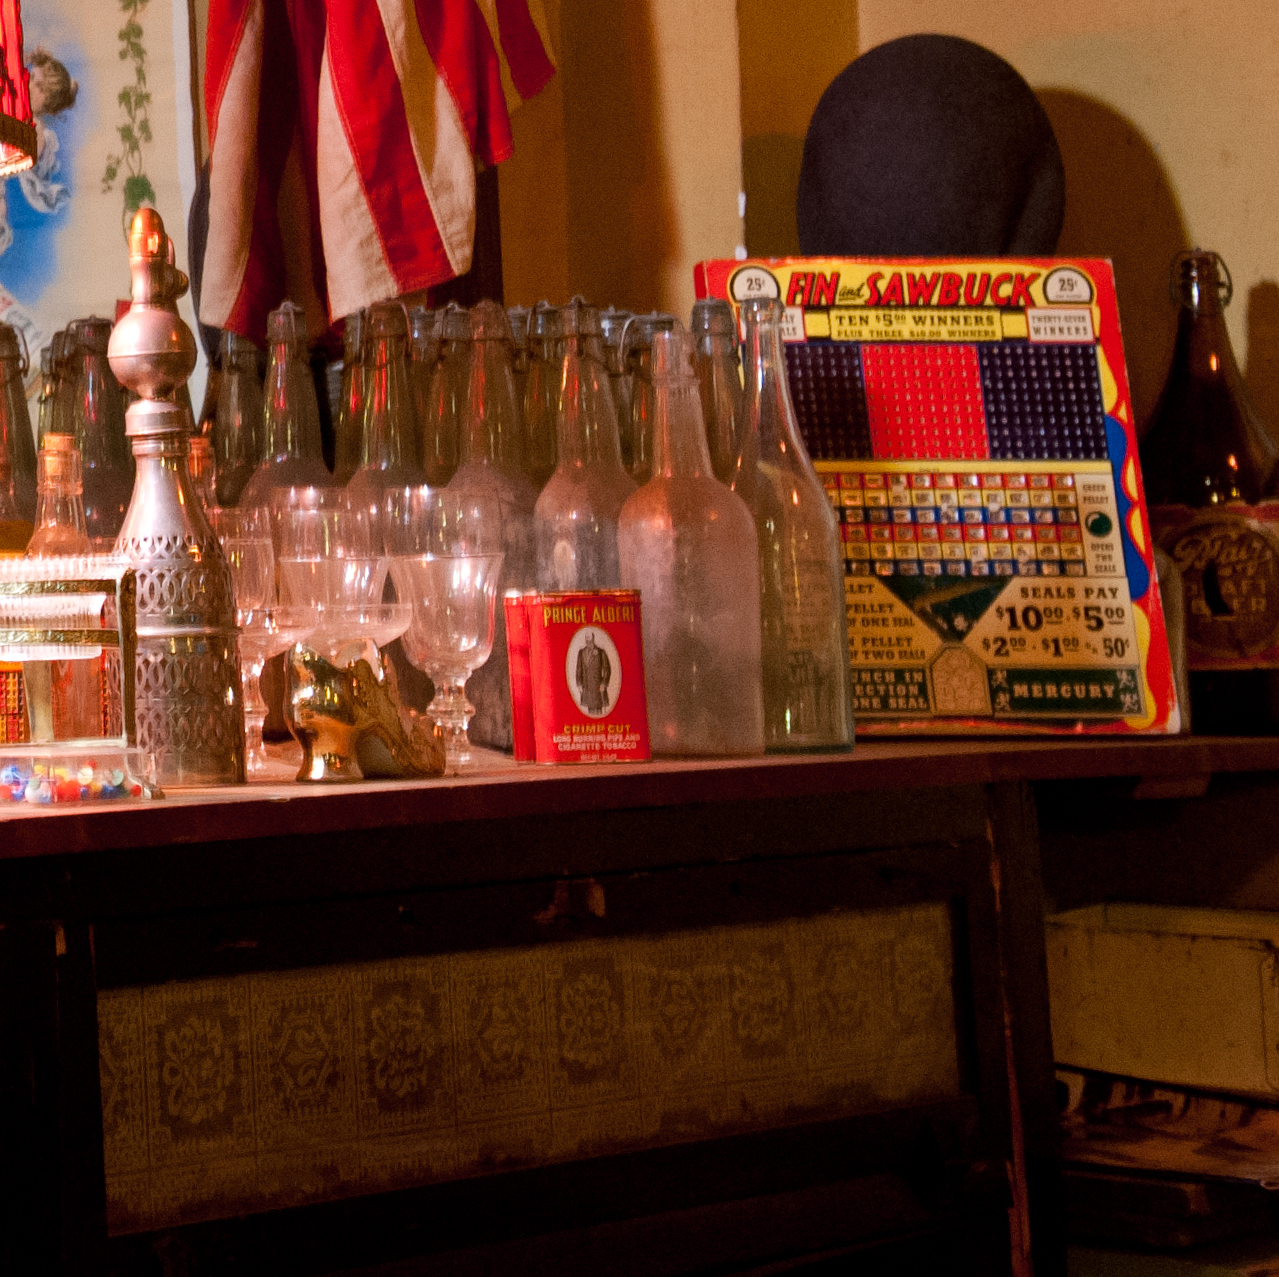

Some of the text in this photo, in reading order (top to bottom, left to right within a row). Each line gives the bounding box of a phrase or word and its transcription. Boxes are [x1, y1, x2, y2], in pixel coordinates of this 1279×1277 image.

[786, 271, 1041, 307] FIN and SAWBUCK
[835, 314, 870, 327] TEN
[911, 314, 996, 327] WINNERS
[837, 330, 864, 338] PLUS
[869, 330, 904, 338] THREE
[947, 330, 997, 338] WINNERS
[1033, 326, 1088, 336] WINNERS
[1019, 586, 1120, 599] SEALS PAY
[543, 605, 636, 628] PRINCE ALBERT
[861, 617, 890, 627] ONE
[862, 636, 913, 647] PELLET
[863, 650, 895, 660] TWO
[904, 672, 923, 683] IN
[854, 684, 919, 696] ECTION
[1012, 681, 1116, 699] MERCURY
[888, 697, 927, 709] SEAL
[563, 725, 631, 734] CRIMP CUT
[602, 742, 638, 750] TOBACCO
